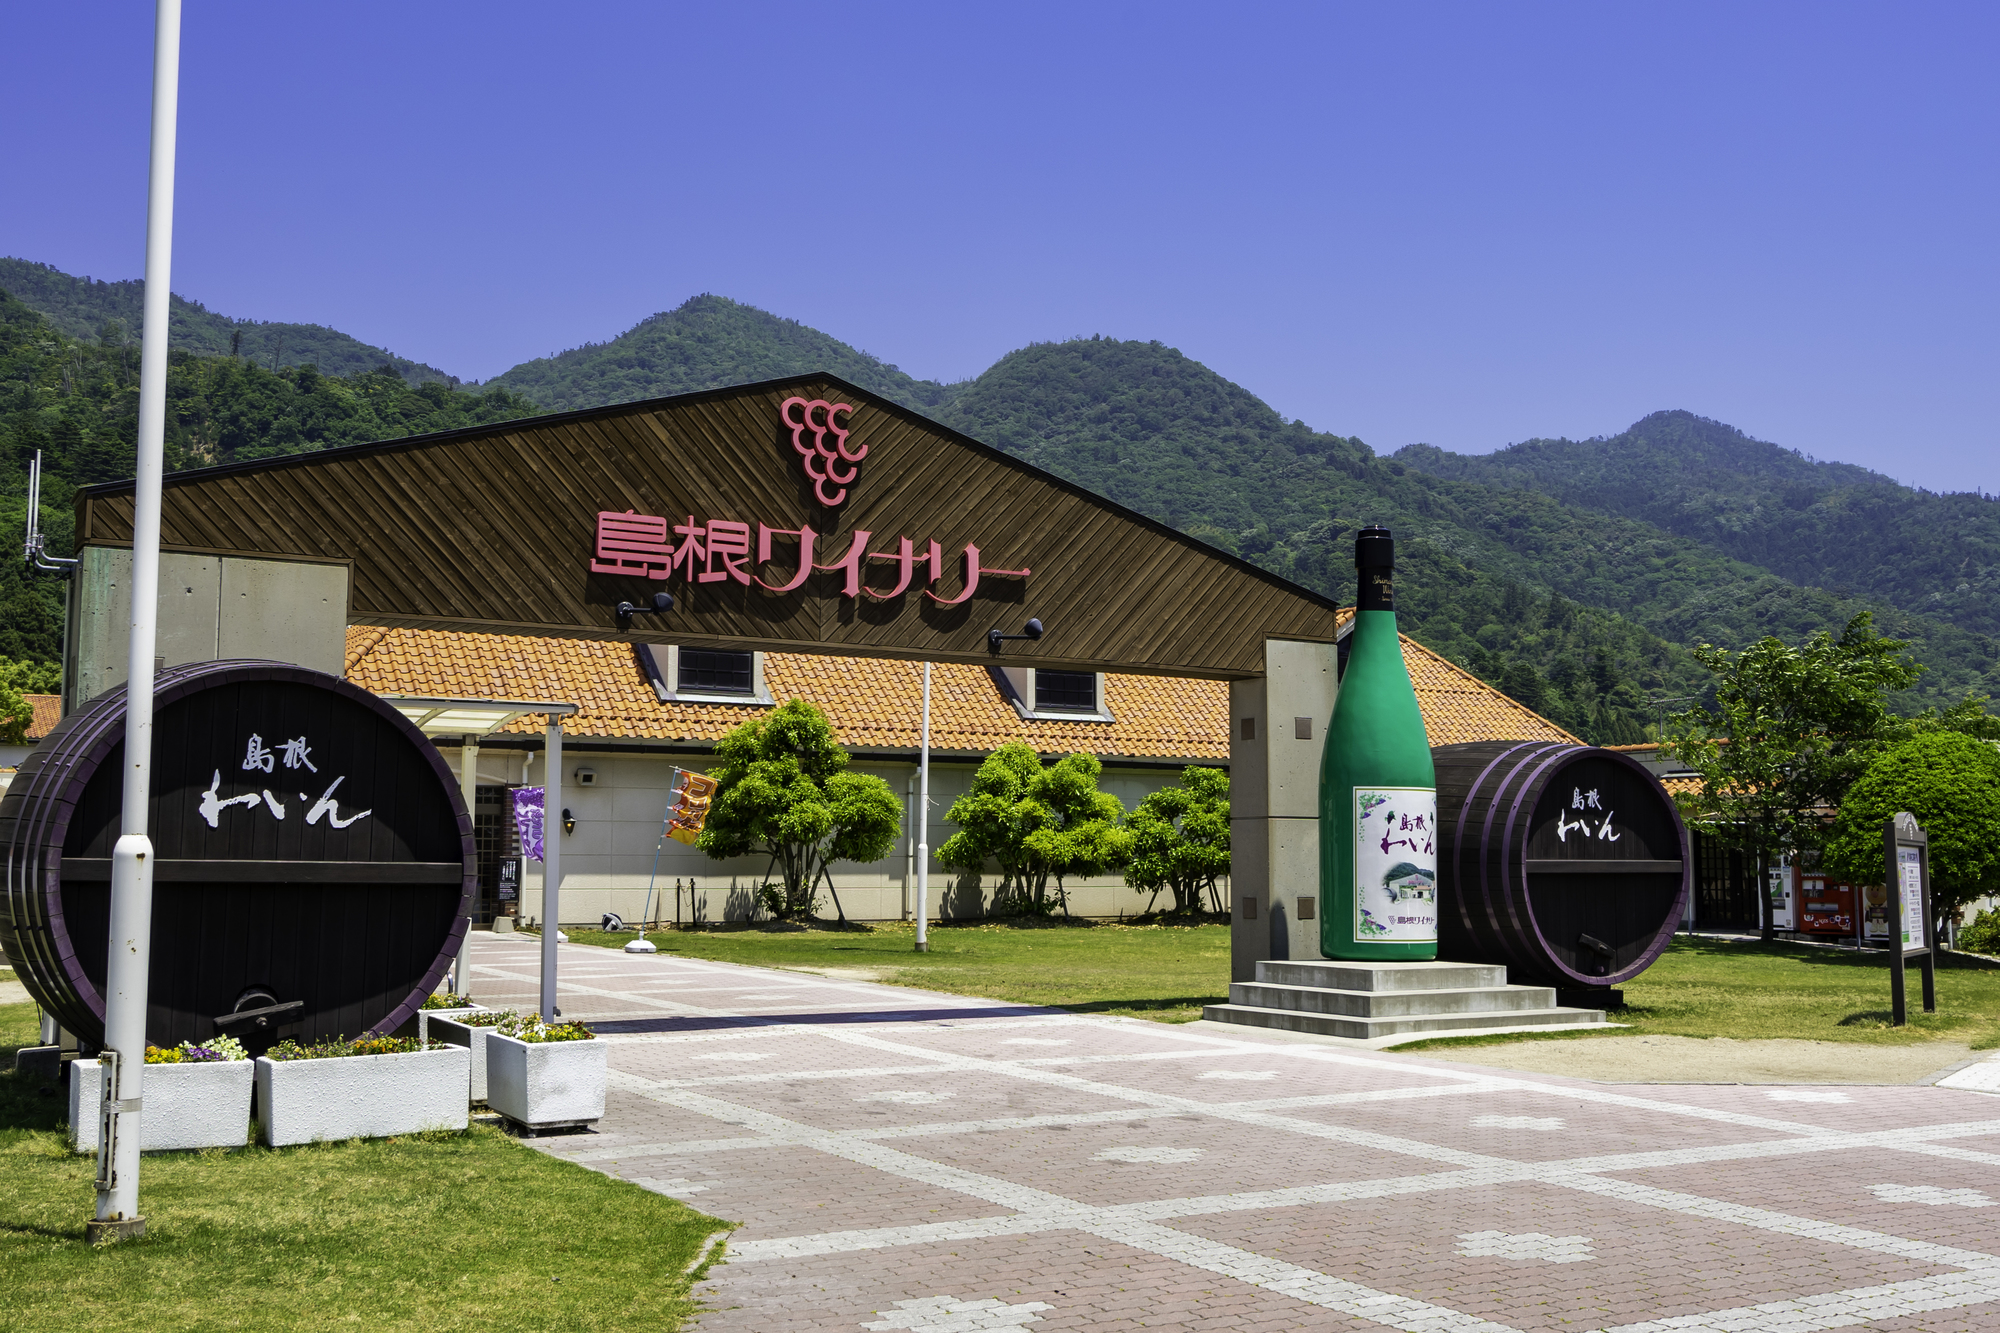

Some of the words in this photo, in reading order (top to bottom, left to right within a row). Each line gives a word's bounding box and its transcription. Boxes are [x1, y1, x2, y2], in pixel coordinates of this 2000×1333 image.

[590, 509, 1031, 604] 島根ワイナリー
[243, 733, 318, 774] 島根
[199, 769, 372, 829] わいん
[1572, 787, 1603, 811] 島根
[1400, 813, 1427, 832] 島根
[1557, 809, 1621, 843] わいん
[1380, 828, 1436, 855] わいん
